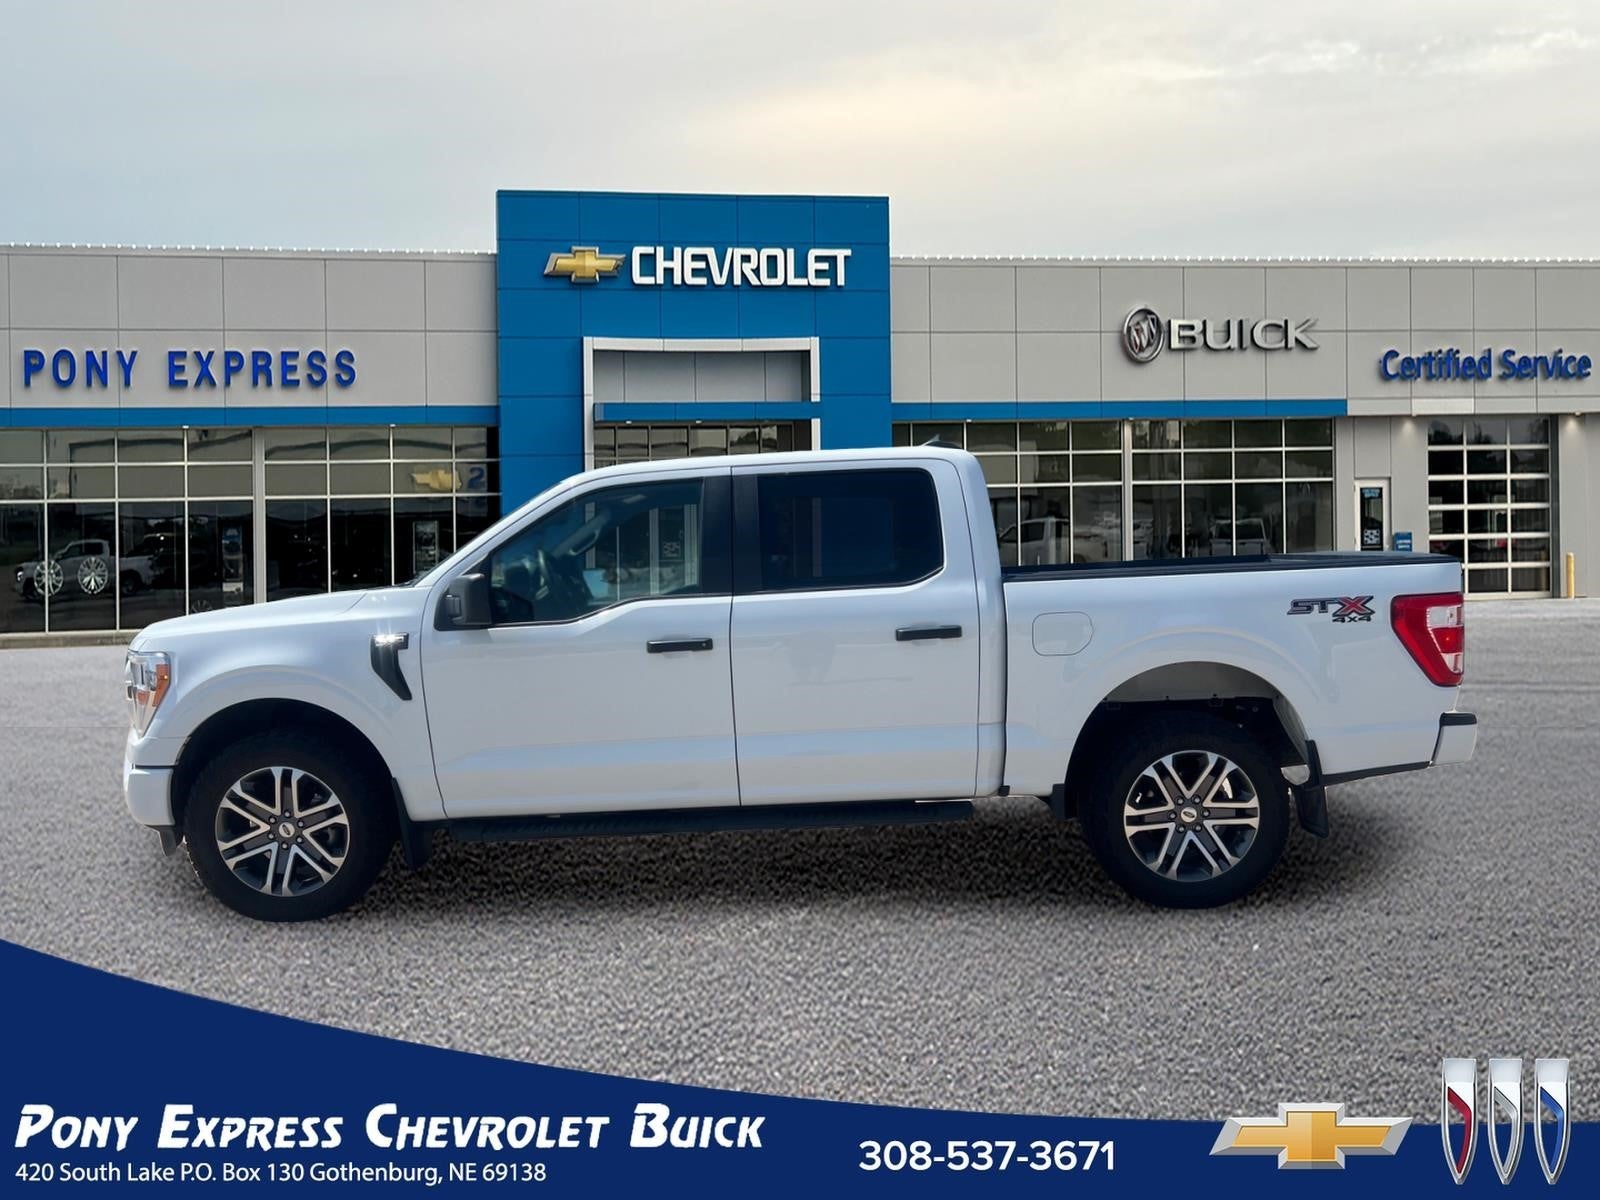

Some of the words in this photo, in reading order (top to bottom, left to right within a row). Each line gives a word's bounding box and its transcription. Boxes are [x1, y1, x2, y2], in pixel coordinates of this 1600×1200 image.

[632, 246, 852, 287] CHEVROLET
[1168, 318, 1319, 351] BUICK
[23, 349, 138, 388] PONY
[167, 349, 357, 388] EXPRESS
[1380, 348, 1493, 381] Certified
[1499, 348, 1592, 380] Service
[1287, 595, 1376, 617] STX
